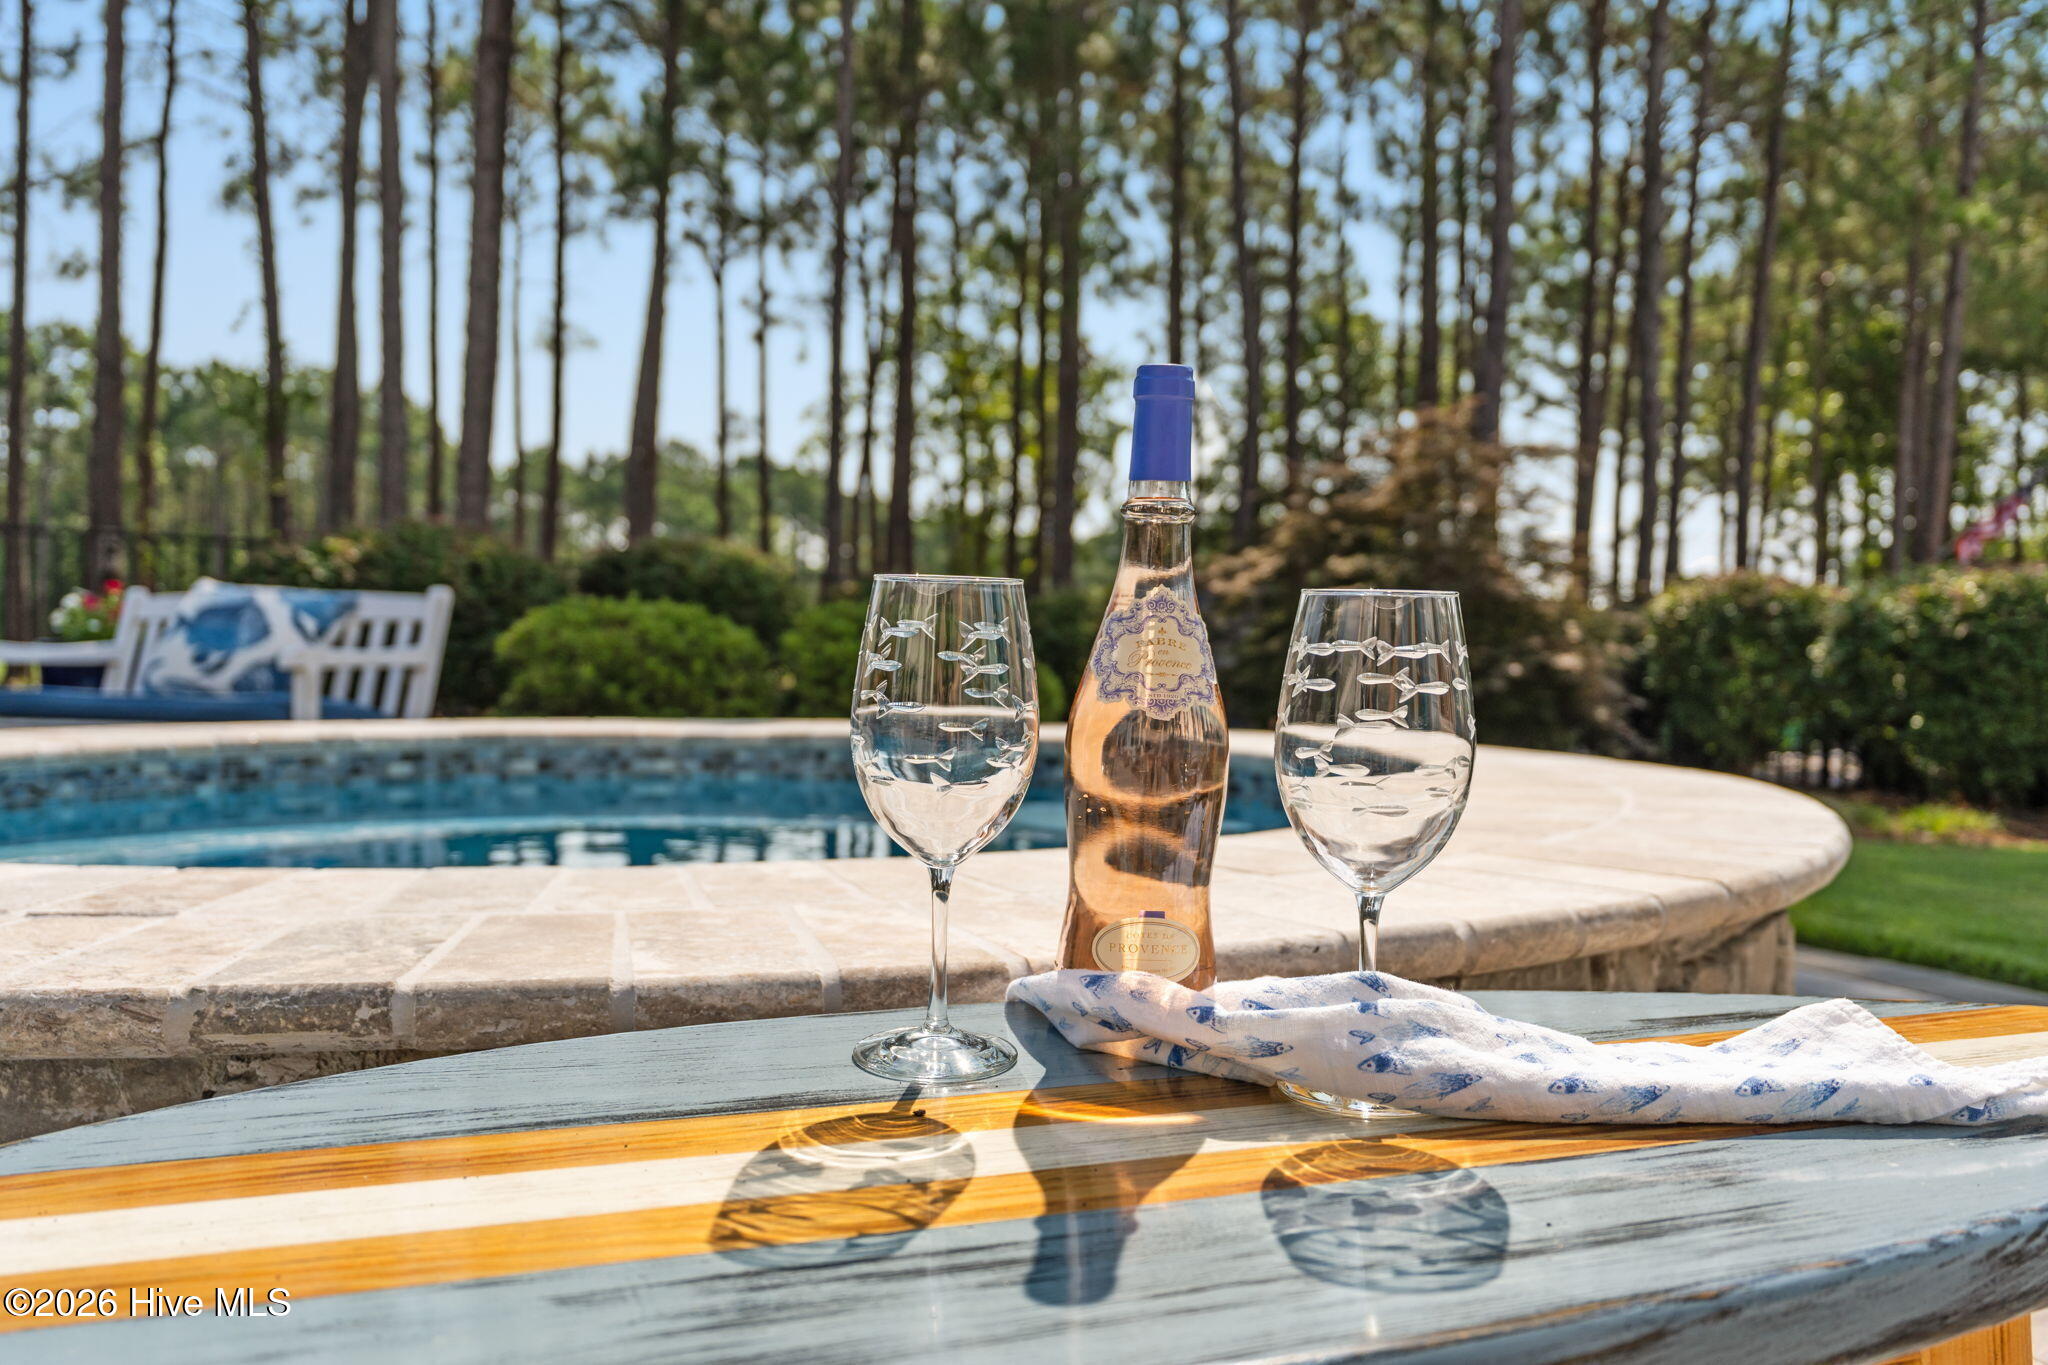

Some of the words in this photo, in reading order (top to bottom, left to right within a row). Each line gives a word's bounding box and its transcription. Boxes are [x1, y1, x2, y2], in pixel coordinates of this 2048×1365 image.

[1135, 637, 1187, 651] FABRE
[1126, 649, 1193, 670] Provence
[1108, 942, 1188, 954] PROVENCE
